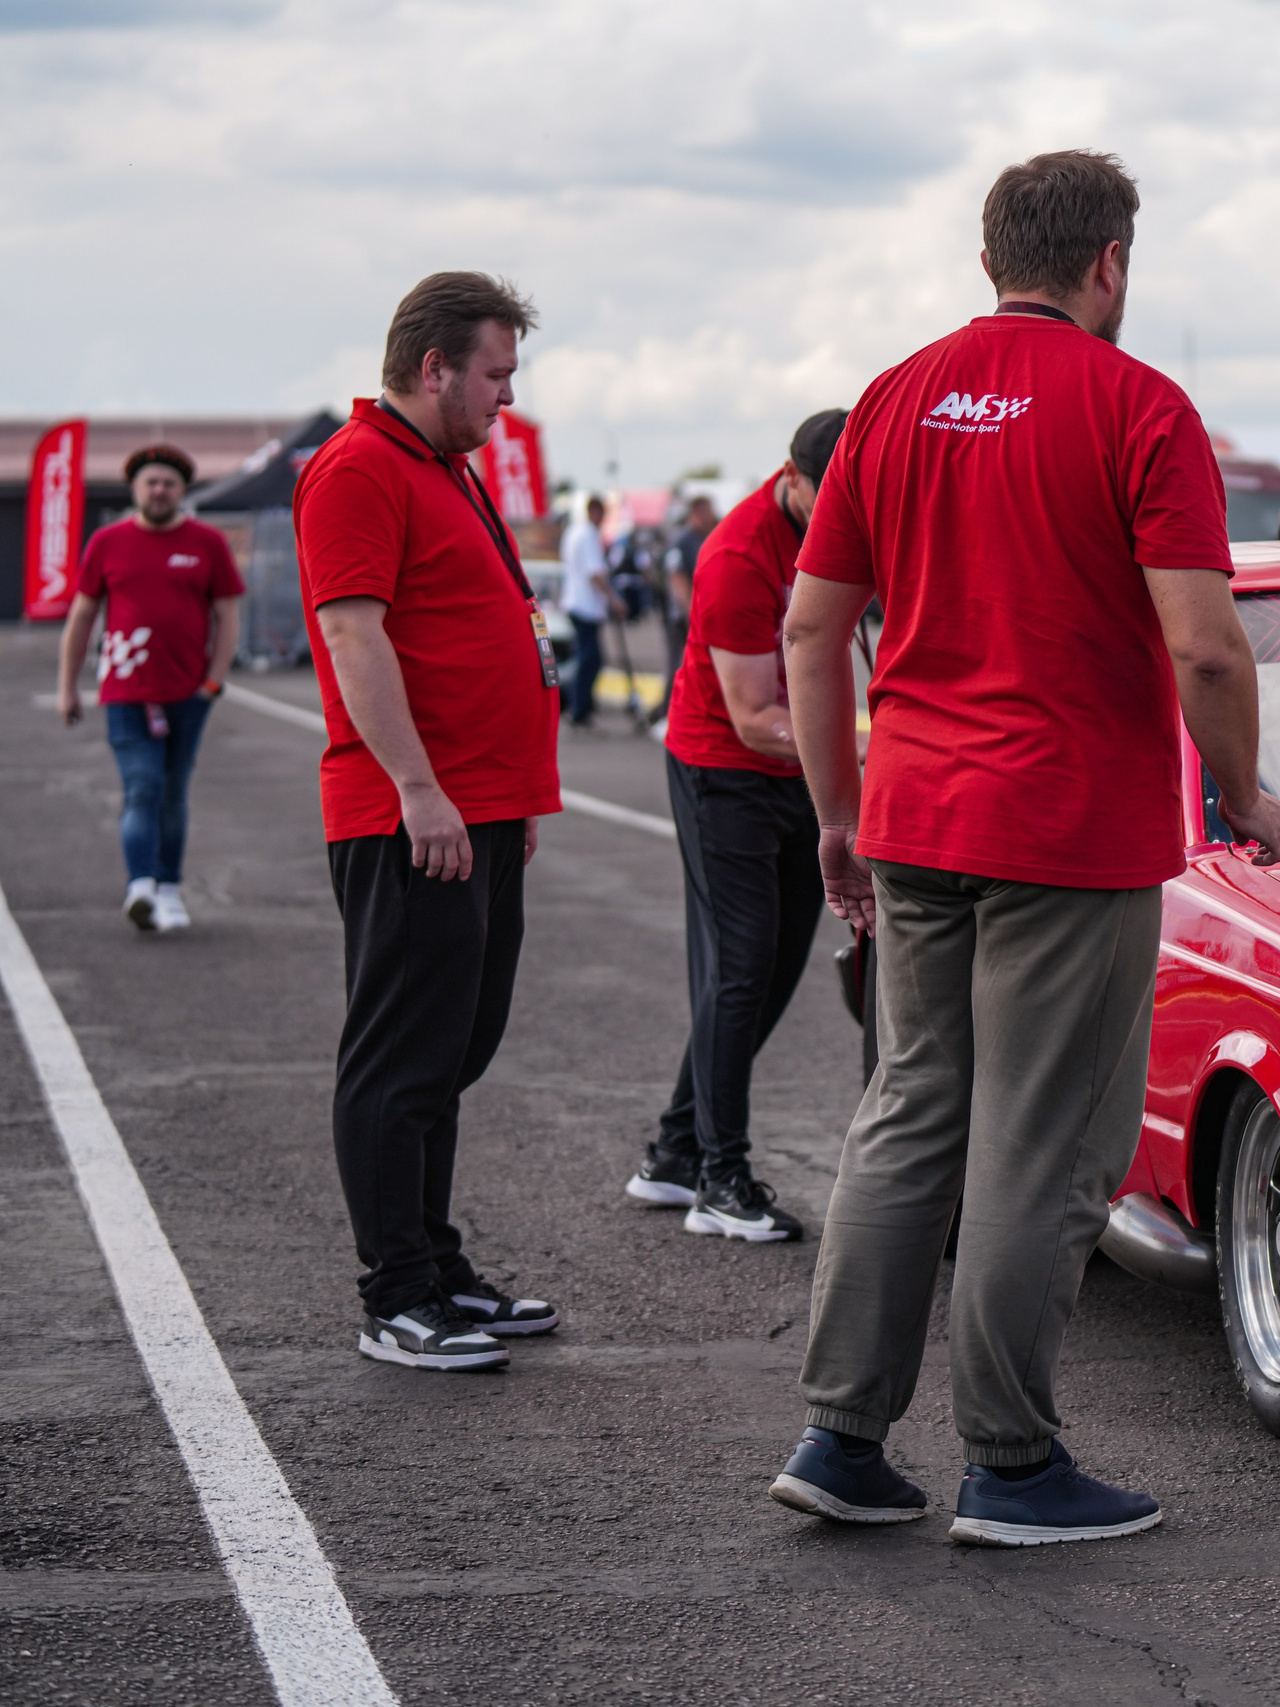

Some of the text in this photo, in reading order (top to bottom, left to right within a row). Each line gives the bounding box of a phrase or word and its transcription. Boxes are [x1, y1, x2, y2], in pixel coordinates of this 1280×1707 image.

[929, 391, 1008, 421] AMS
[920, 417, 1000, 434] Alania Motor Sport
